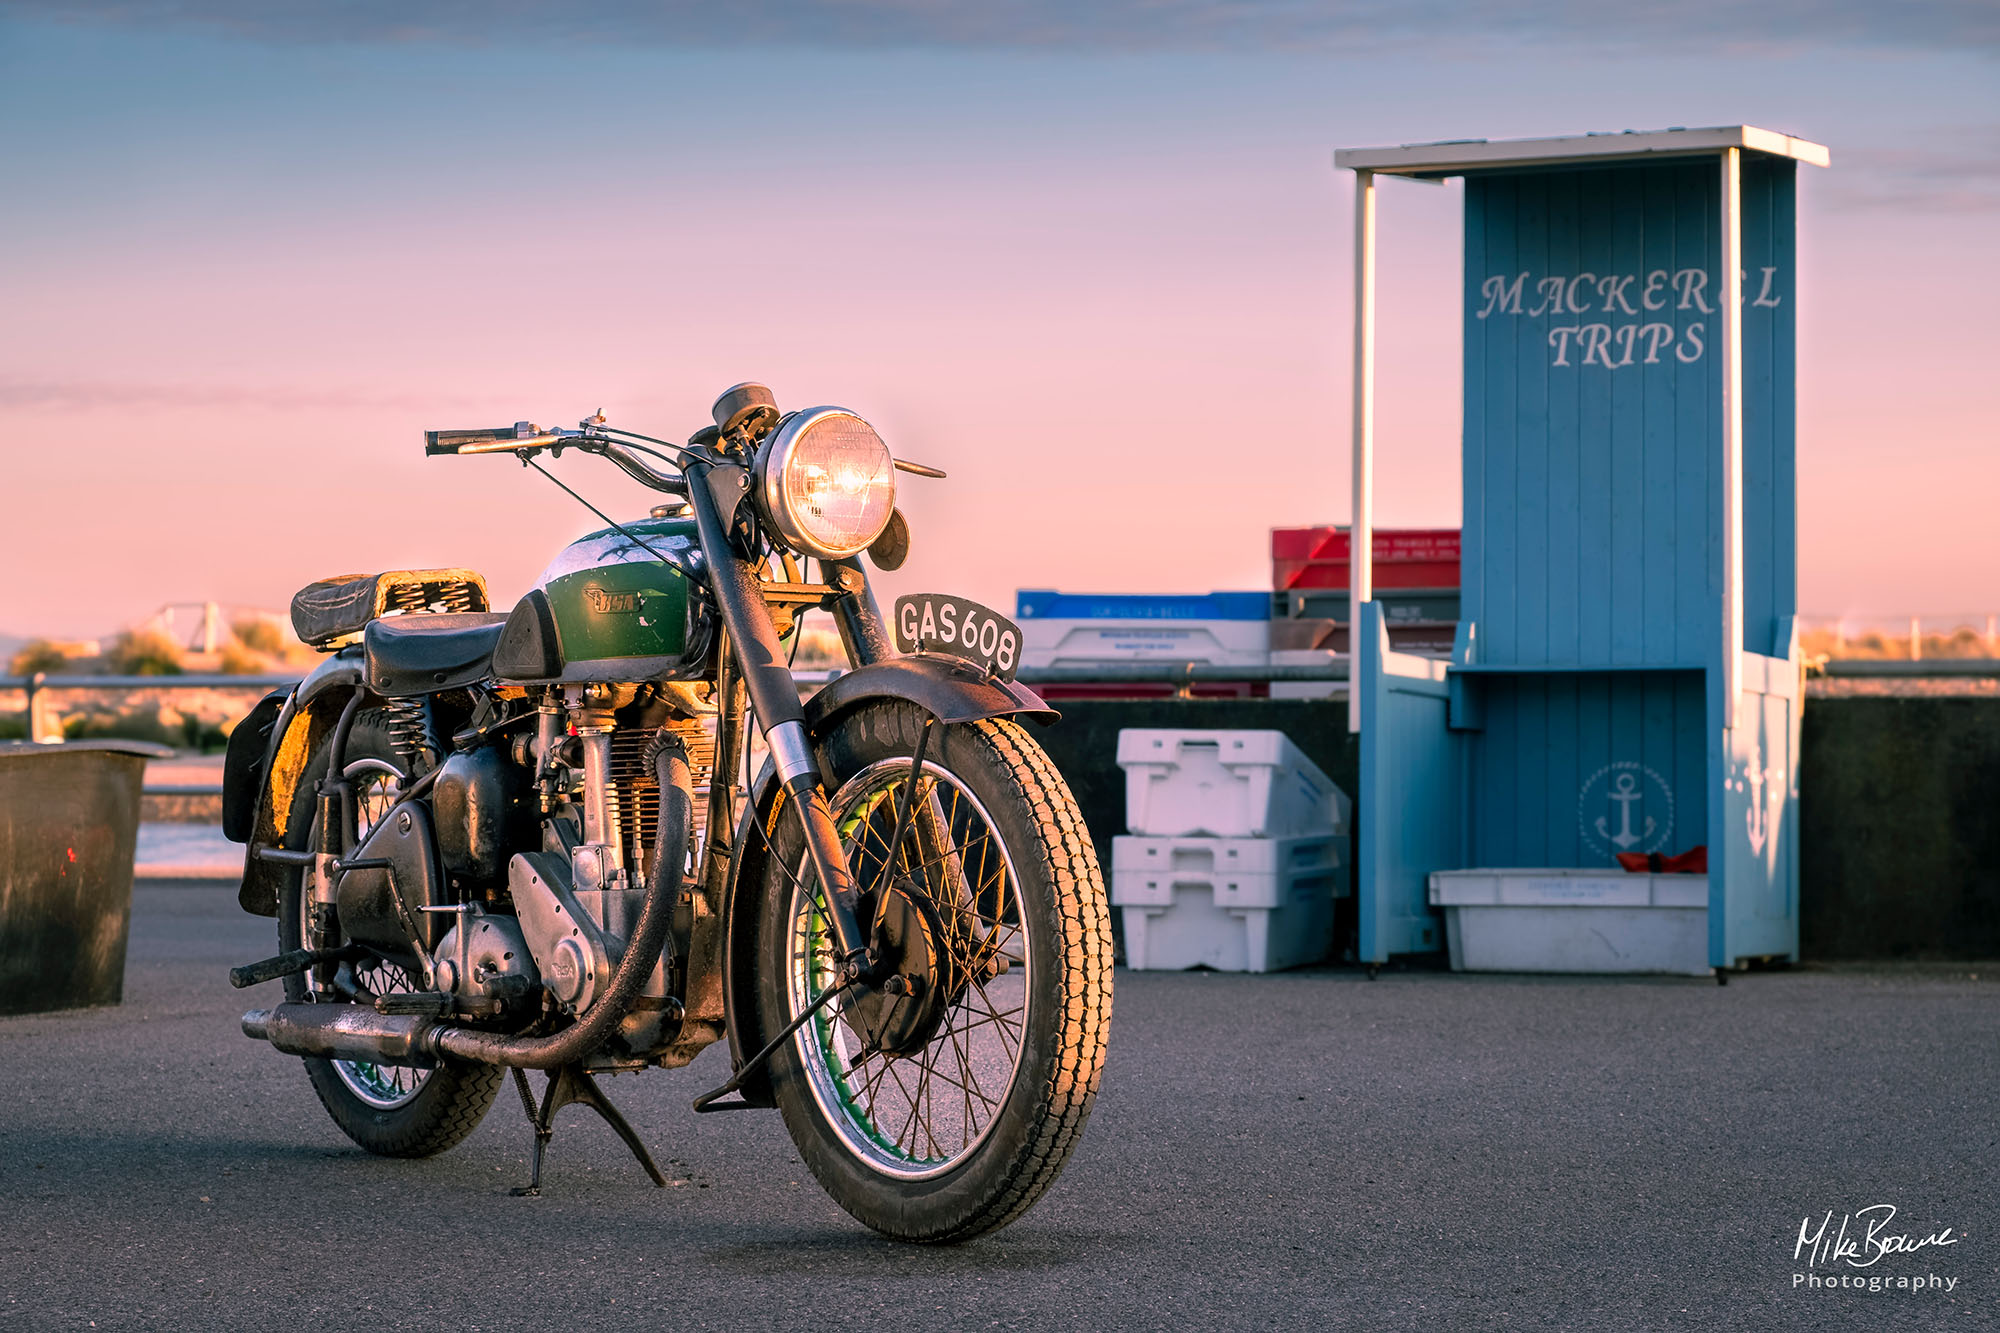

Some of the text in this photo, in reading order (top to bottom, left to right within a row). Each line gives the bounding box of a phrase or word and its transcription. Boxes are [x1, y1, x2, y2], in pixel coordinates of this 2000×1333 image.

[1476, 267, 1781, 319] MACKERL
[1548, 322, 1705, 370] TRIPS
[900, 601, 1016, 671] GAS 608
